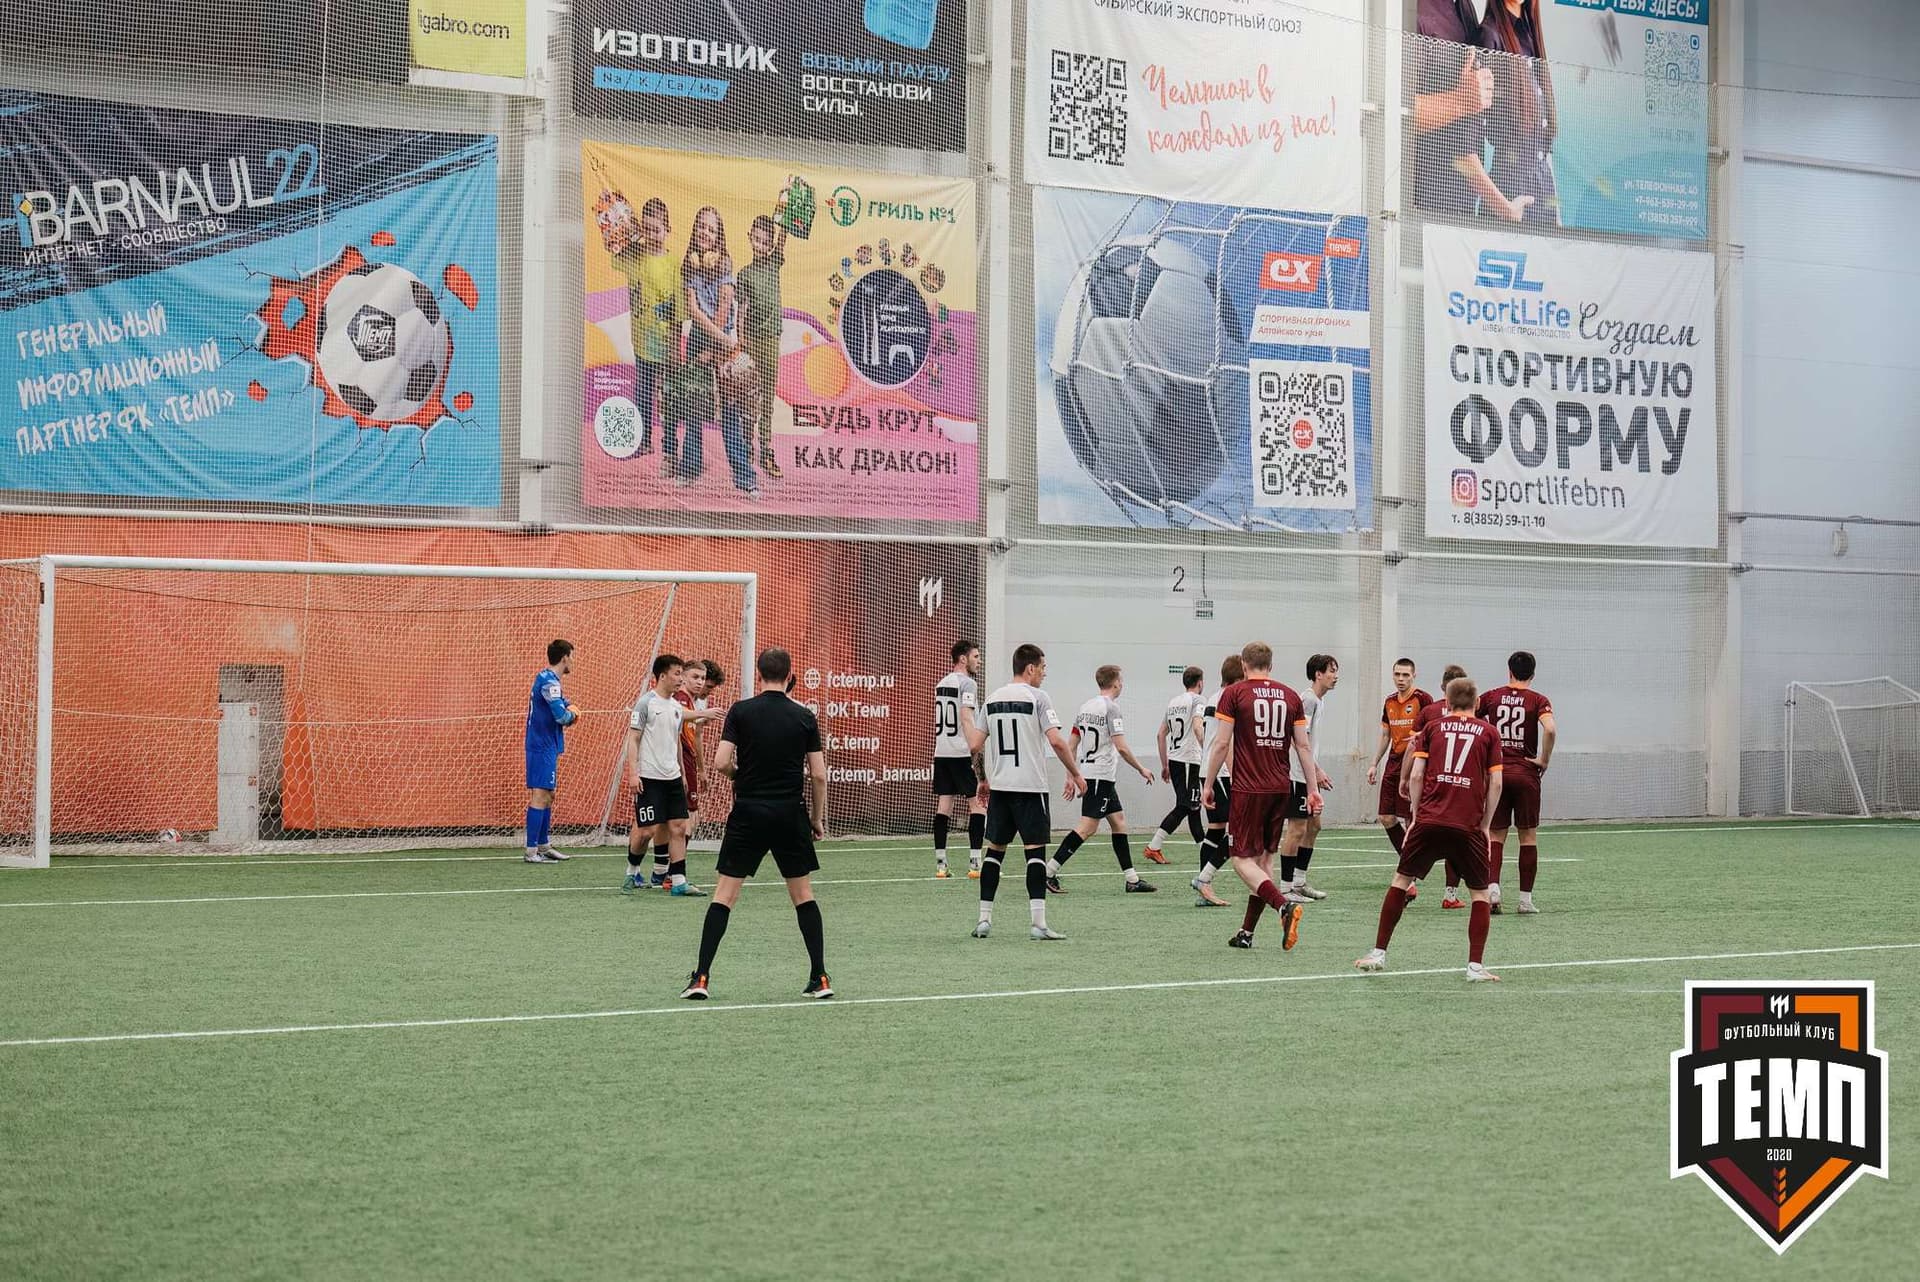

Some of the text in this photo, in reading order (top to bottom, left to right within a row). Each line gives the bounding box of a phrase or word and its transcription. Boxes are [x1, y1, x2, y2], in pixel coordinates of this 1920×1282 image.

[417, 8, 510, 39] ligabro.com
[1177, 5, 1265, 31] ЭКСПОРТНЫЙ
[1268, 17, 1302, 34] СОЮЗ
[593, 27, 779, 74] ИЗОТОНИК
[802, 74, 932, 101] ВОССТАНОВИ
[1142, 64, 1254, 111] Чемпион
[803, 95, 863, 116] СИЛЫ.
[1148, 95, 1336, 153] каждом из нас!
[868, 200, 924, 220] ГРИЛЬ
[23, 239, 106, 266] ИНТЕРНЕТ
[121, 216, 227, 250] СООБЩЕСТВО
[1448, 291, 1570, 329] SportLife
[16, 300, 167, 360] ГЕНЕРАЛЬНЫЙ
[1578, 302, 1700, 354] Создаем
[17, 336, 221, 411] ИНФОРМАЦИОННЫЙ
[1449, 344, 1693, 399] СПОРТИВНУЮ
[15, 387, 235, 457] ПАРТНЕР ФК «ТЕМП»
[792, 404, 943, 439] БУДЬ КРУТ,
[1449, 394, 1691, 476] ФОРМУ
[794, 446, 958, 476] КАК ДРАКОН!
[1481, 475, 1625, 509] sportlifebrn
[1172, 565, 1185, 593] 2
[826, 671, 895, 692] fctemp.ru
[826, 701, 890, 718] ФК Темп
[1253, 698, 1287, 739] 90
[1496, 704, 1526, 741] 22
[825, 733, 881, 754] fc.temp
[997, 718, 1020, 767] 4
[1256, 738, 1284, 748] SEUS
[1440, 721, 1484, 736] КУЗЬКИН
[1444, 732, 1475, 775] 17
[826, 763, 935, 786] fctemp_barnaul
[1436, 774, 1471, 786] SEUS
[639, 806, 655, 823] 66
